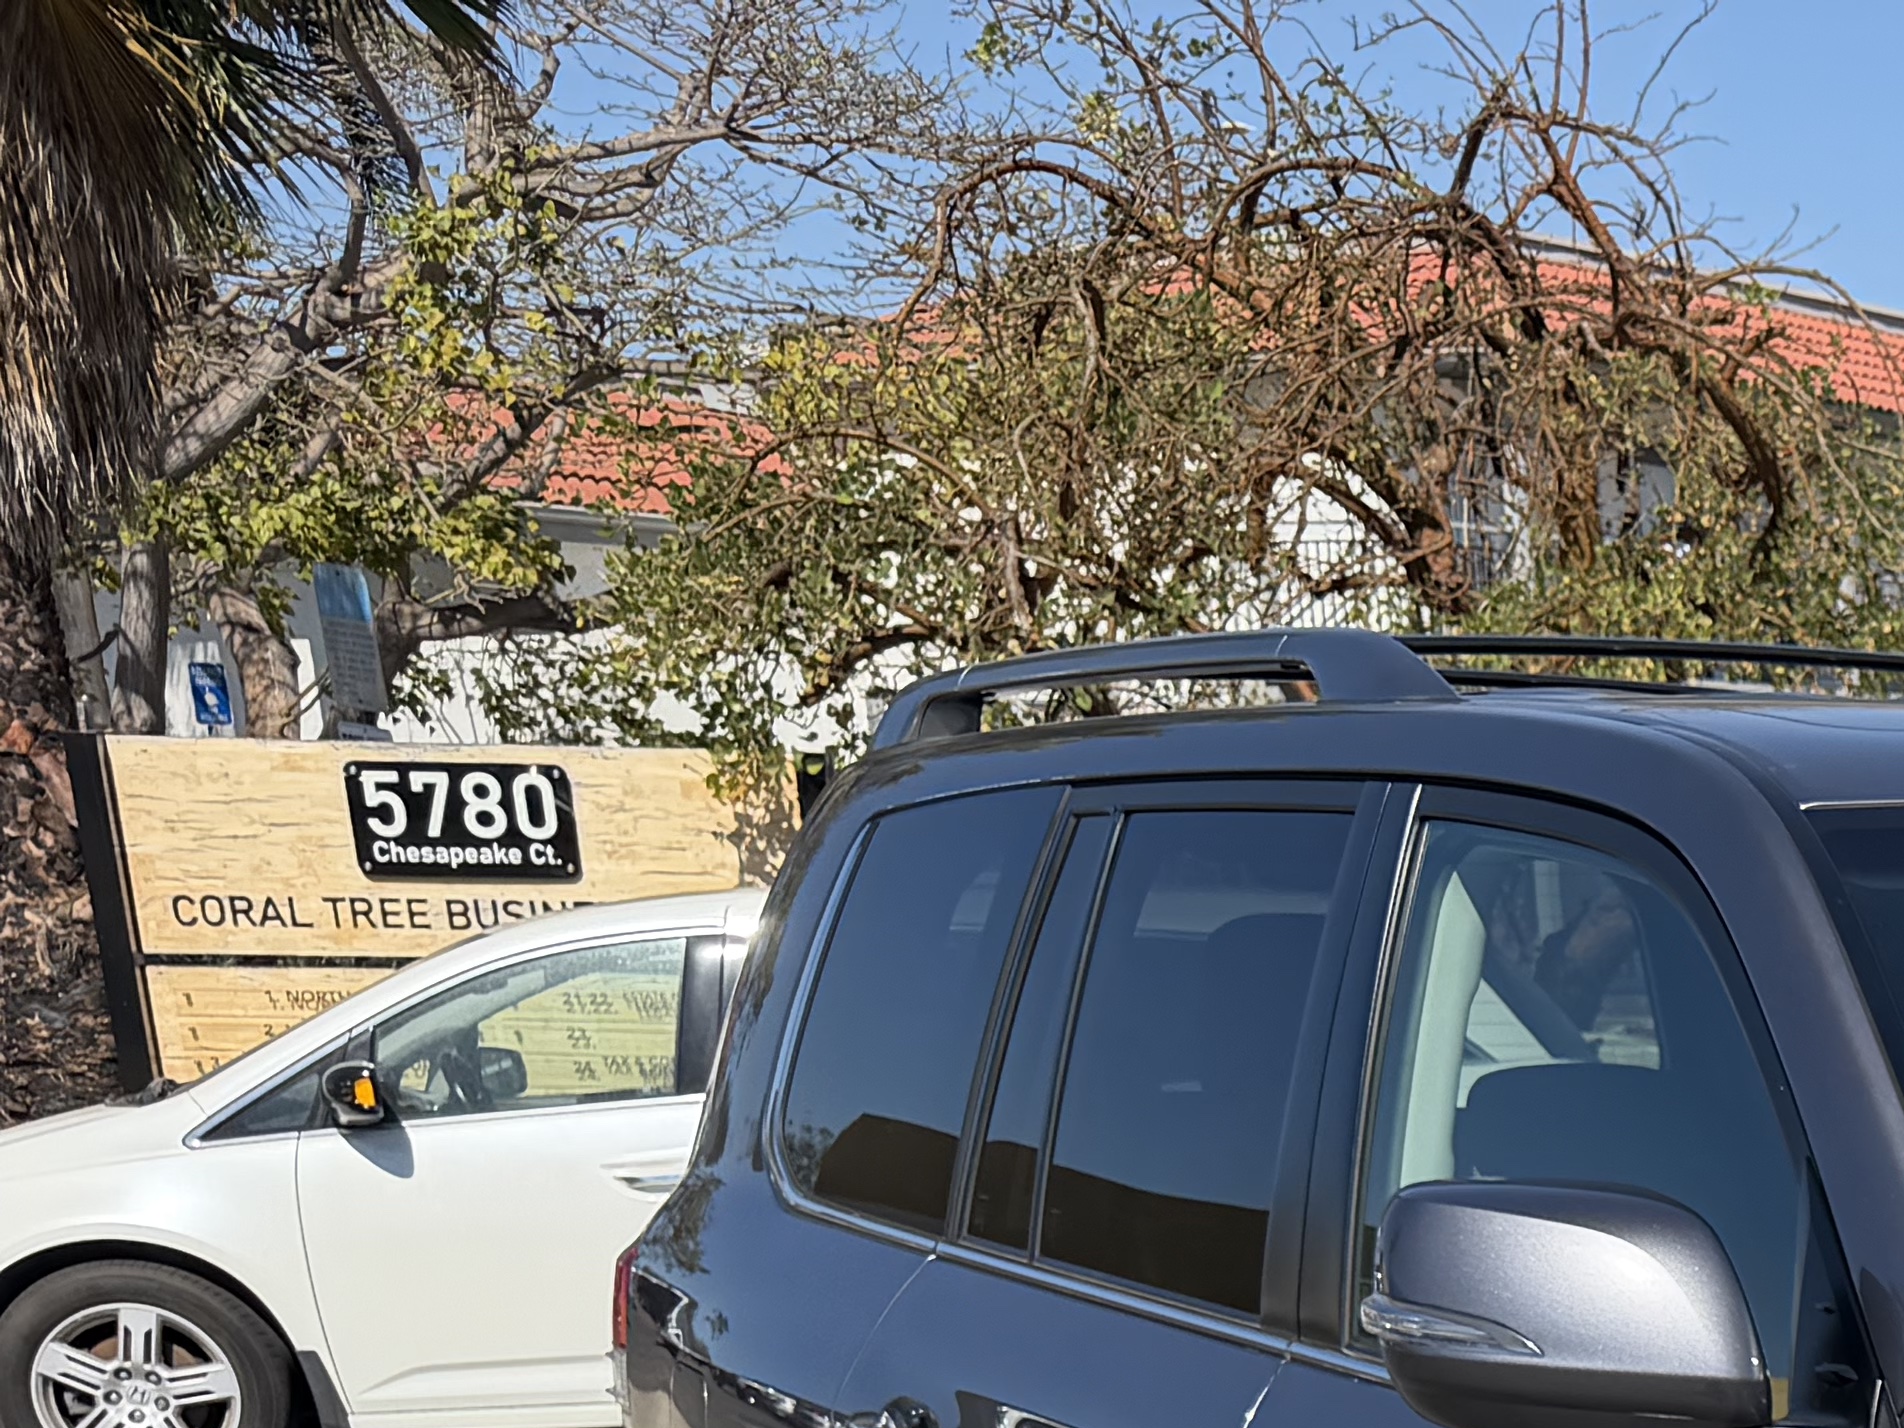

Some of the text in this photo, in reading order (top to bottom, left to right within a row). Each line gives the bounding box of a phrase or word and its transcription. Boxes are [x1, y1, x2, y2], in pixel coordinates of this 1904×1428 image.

[359, 769, 557, 840] 5780
[372, 840, 563, 869] Chesapeake Ct.
[171, 894, 595, 931] CORAL TREE BUSI
